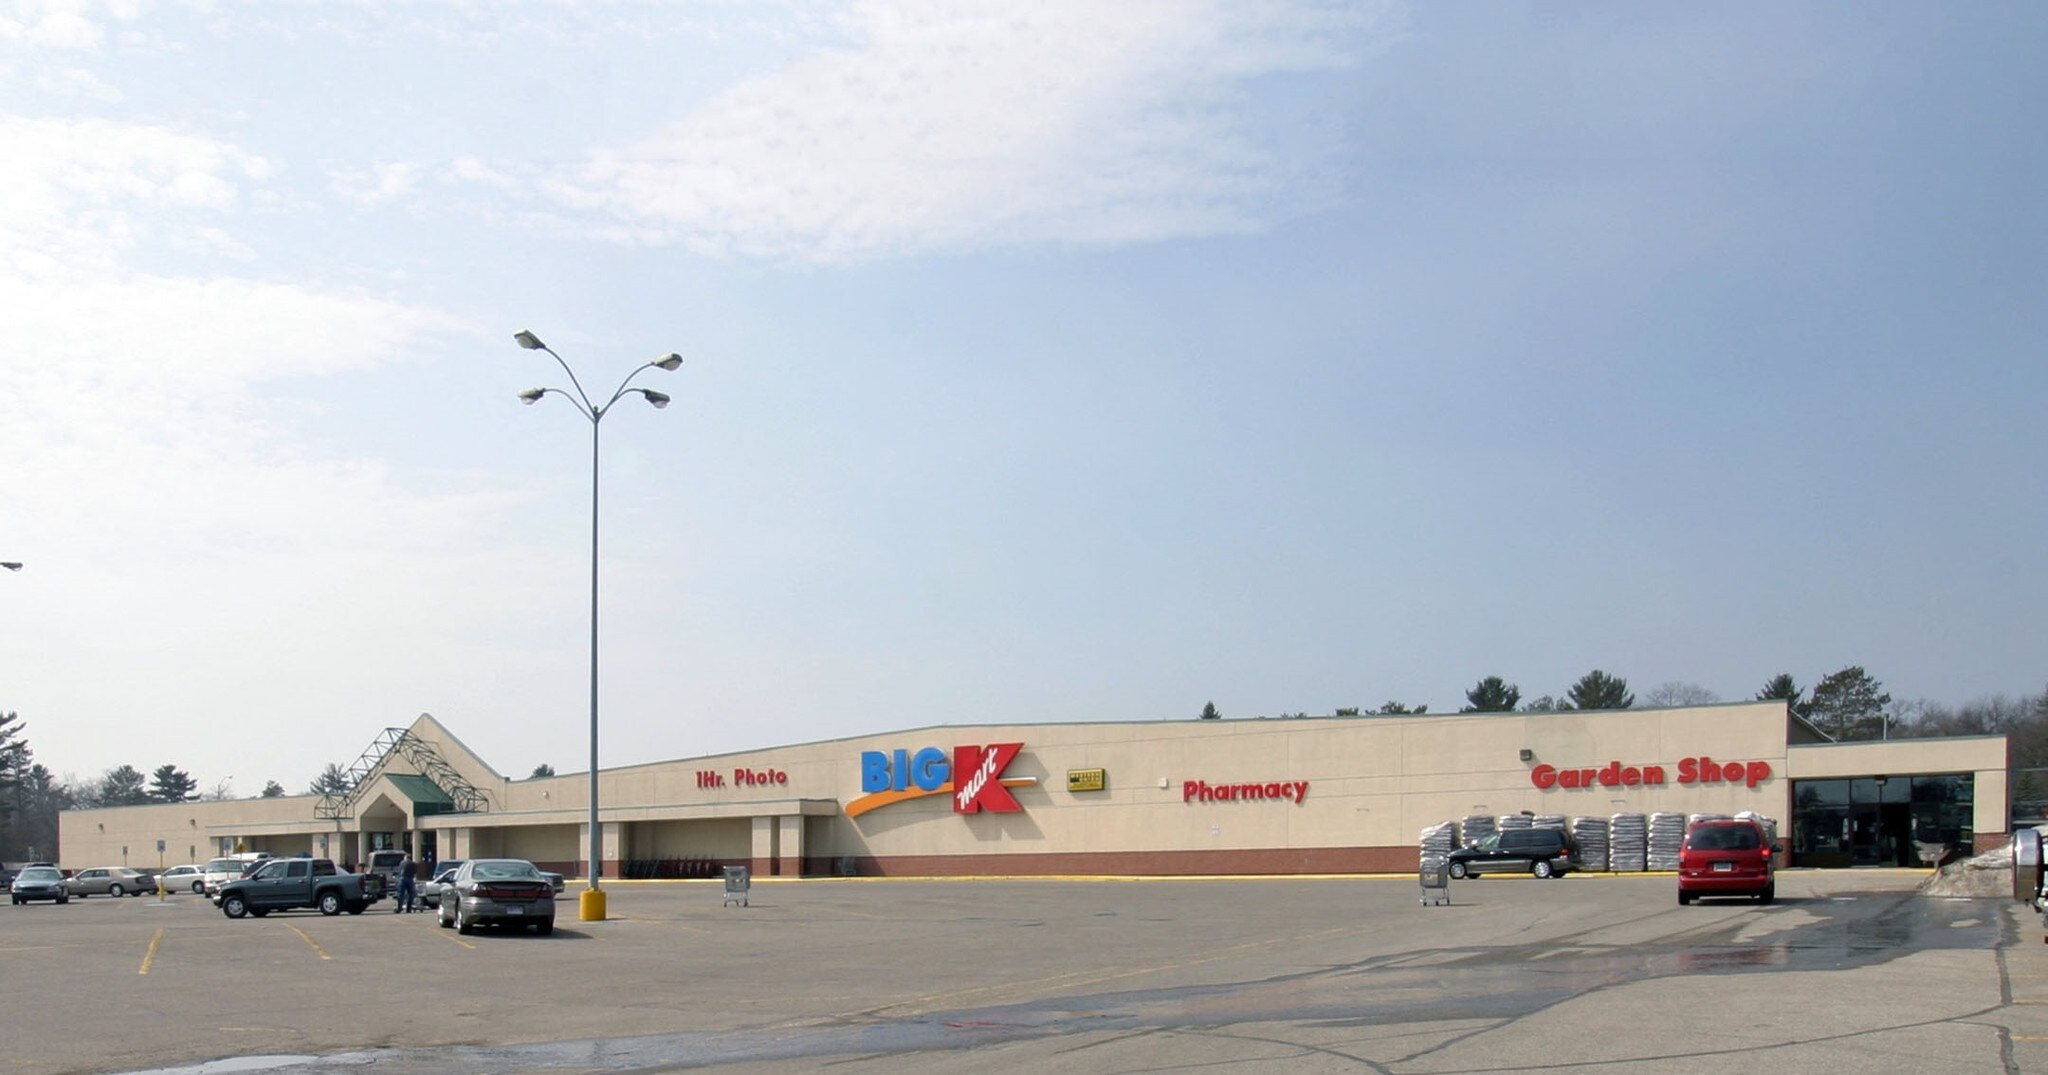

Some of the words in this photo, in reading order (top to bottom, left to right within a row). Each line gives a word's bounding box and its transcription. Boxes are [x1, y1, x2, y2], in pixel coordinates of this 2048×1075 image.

[734, 768, 787, 786] Photo
[861, 746, 950, 793] BIG
[953, 742, 1025, 814] K
[957, 747, 998, 811] mart
[1531, 761, 1665, 789] Garden
[1677, 757, 1771, 788] Shop
[1183, 780, 1308, 804] Pharmacy
